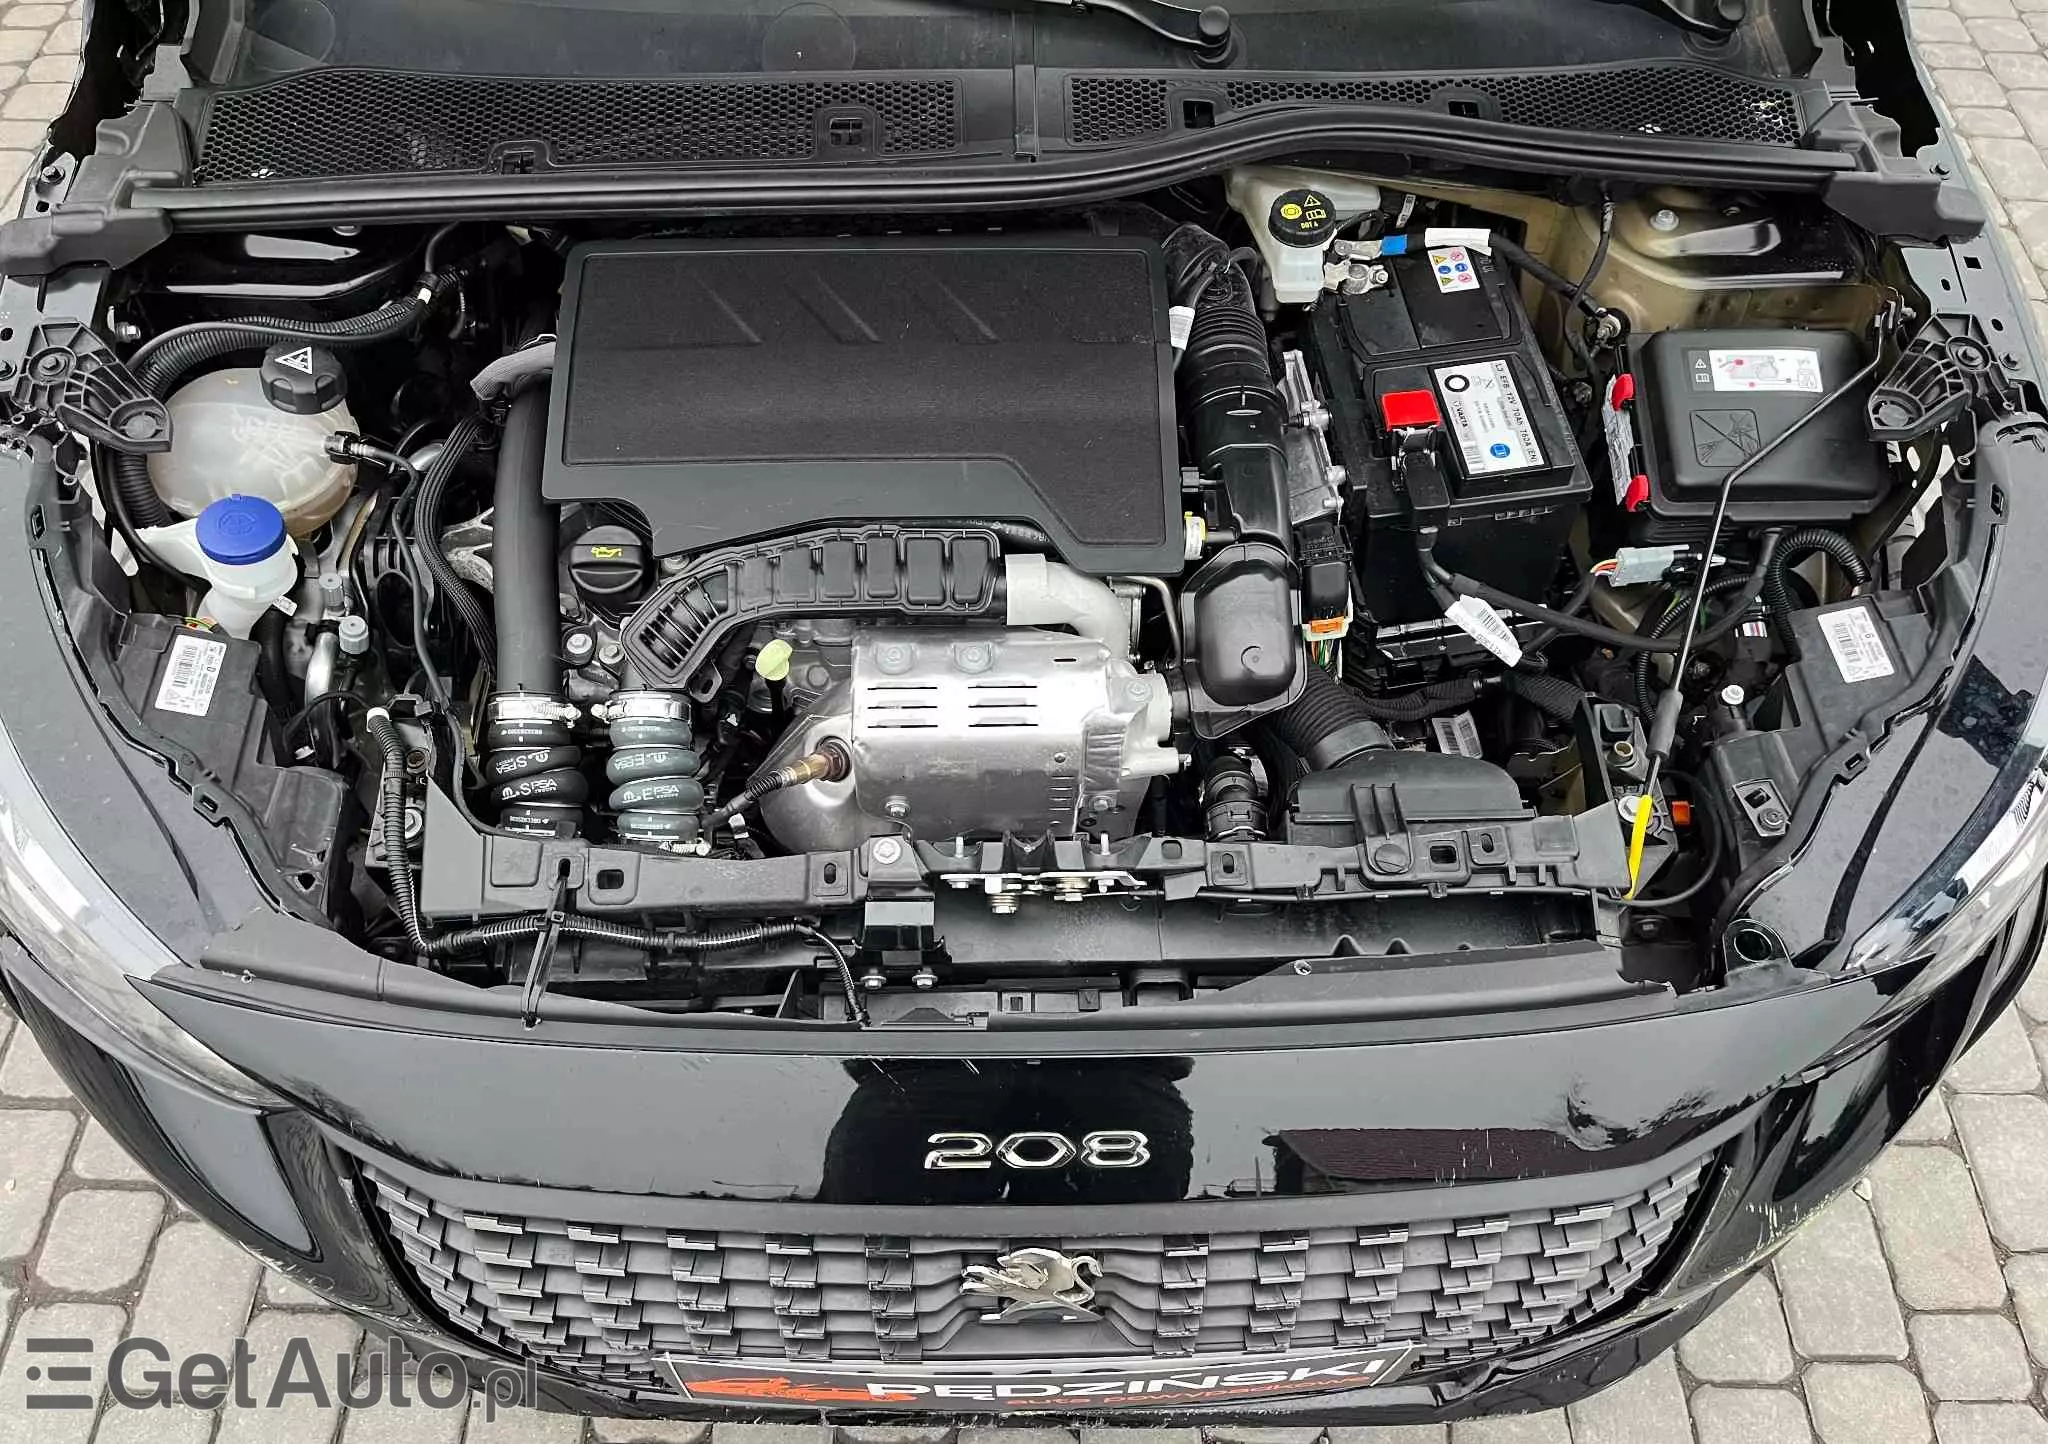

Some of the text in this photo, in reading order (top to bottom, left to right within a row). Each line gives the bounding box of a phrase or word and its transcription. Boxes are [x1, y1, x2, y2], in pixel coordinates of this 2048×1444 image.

[531, 778, 558, 791] PSA
[653, 784, 680, 797] PSA
[924, 1130, 1151, 1169] 208
[866, 1359, 1387, 1401] PĘDZIŃSKI
